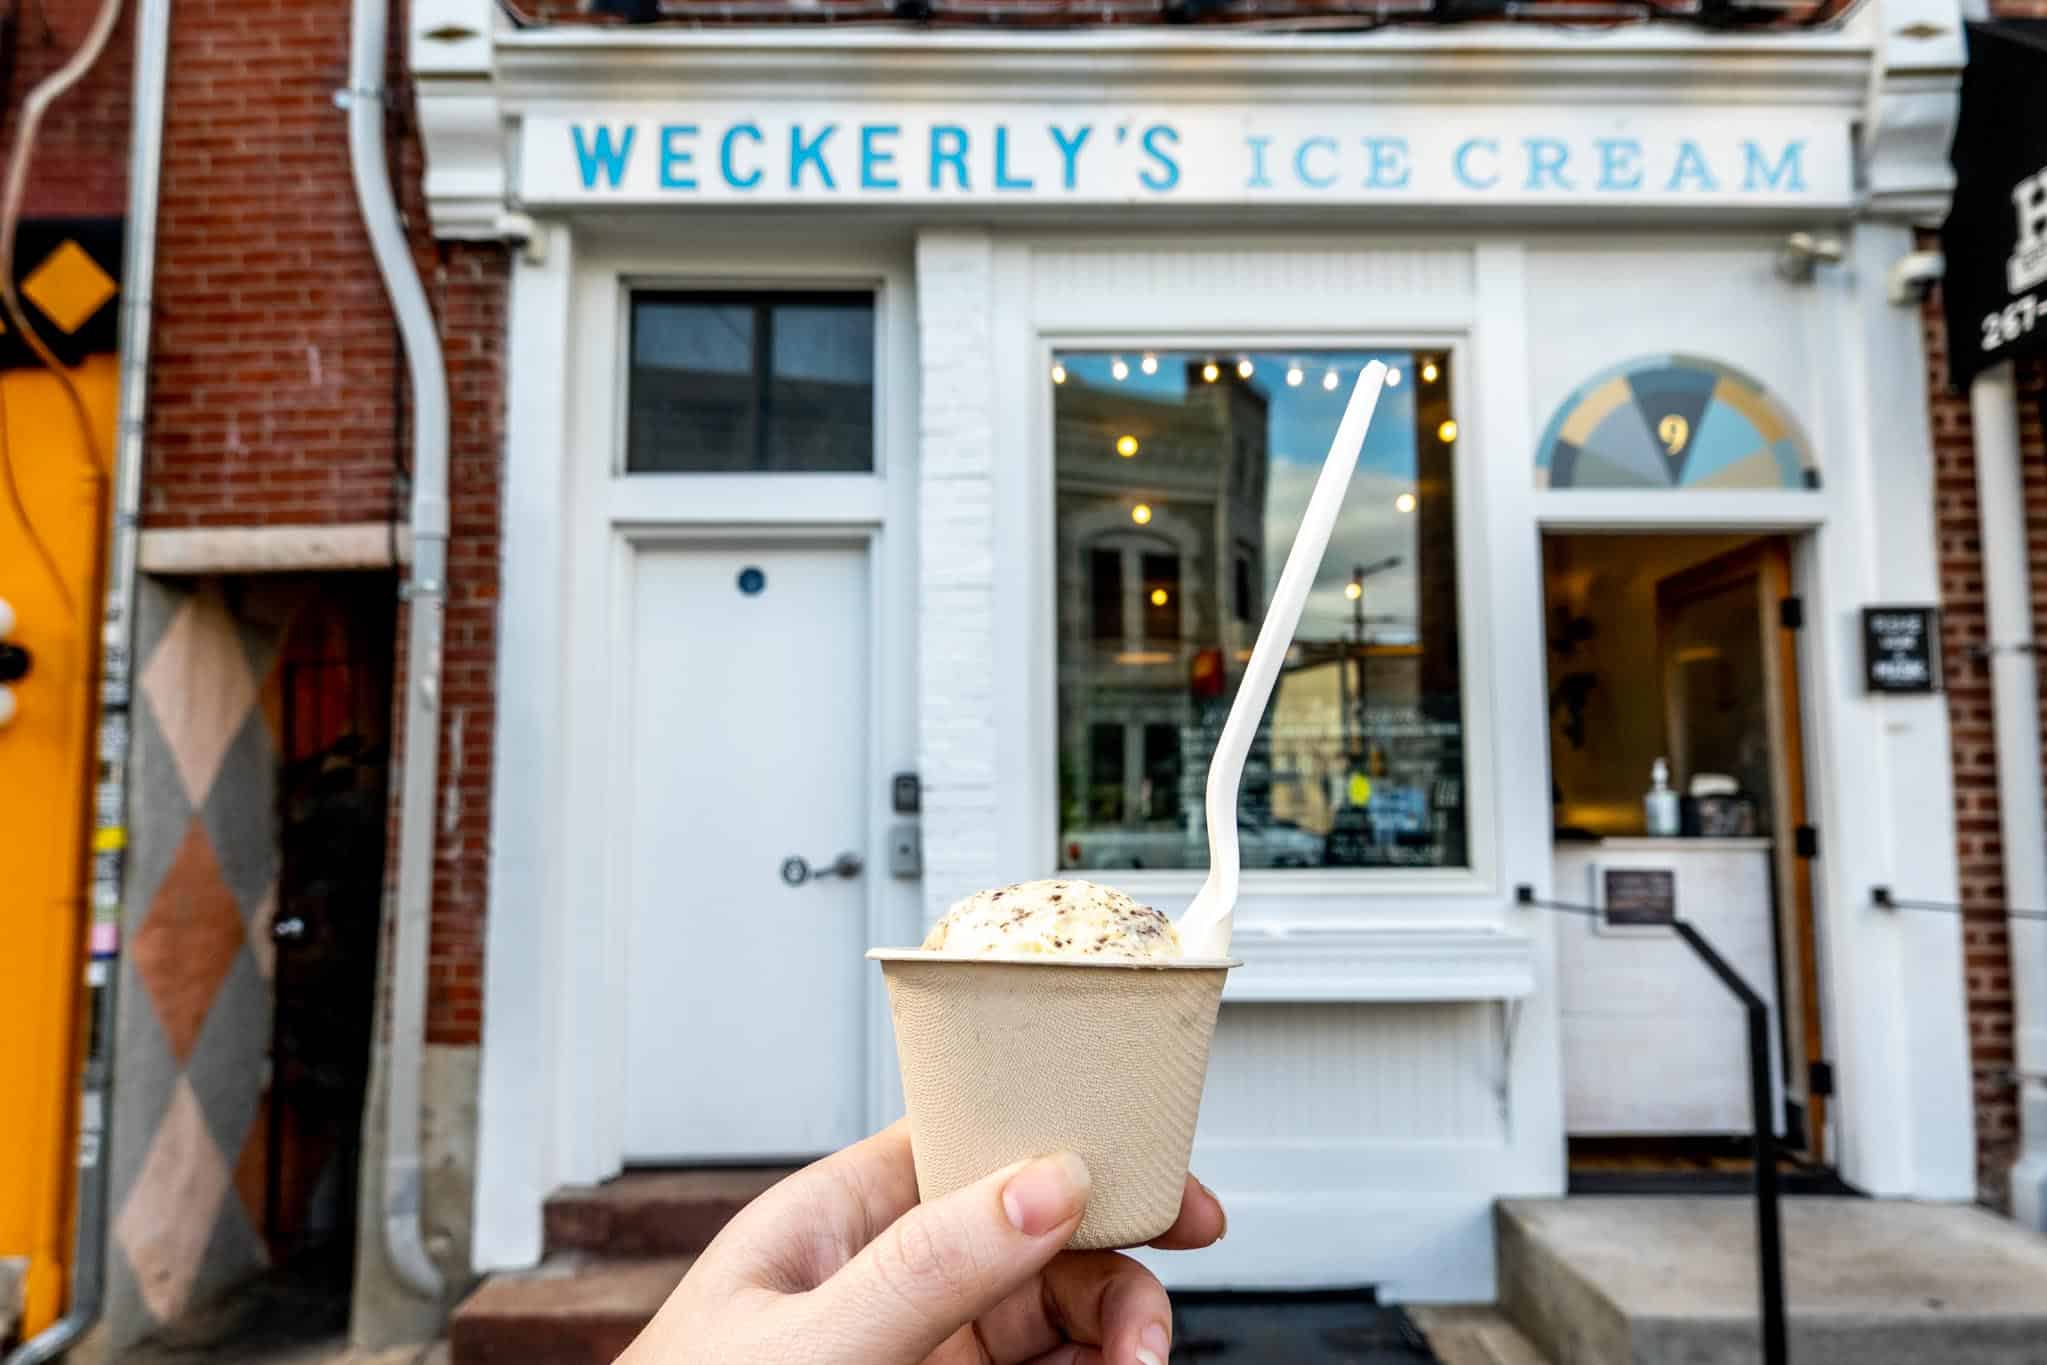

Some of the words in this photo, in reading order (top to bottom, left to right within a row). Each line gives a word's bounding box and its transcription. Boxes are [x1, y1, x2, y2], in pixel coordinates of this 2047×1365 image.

[571, 122, 1181, 191] WECKERLY'S
[1244, 136, 1412, 188] ICE
[1452, 138, 1809, 192] CREAM
[1658, 413, 1689, 456] 9
